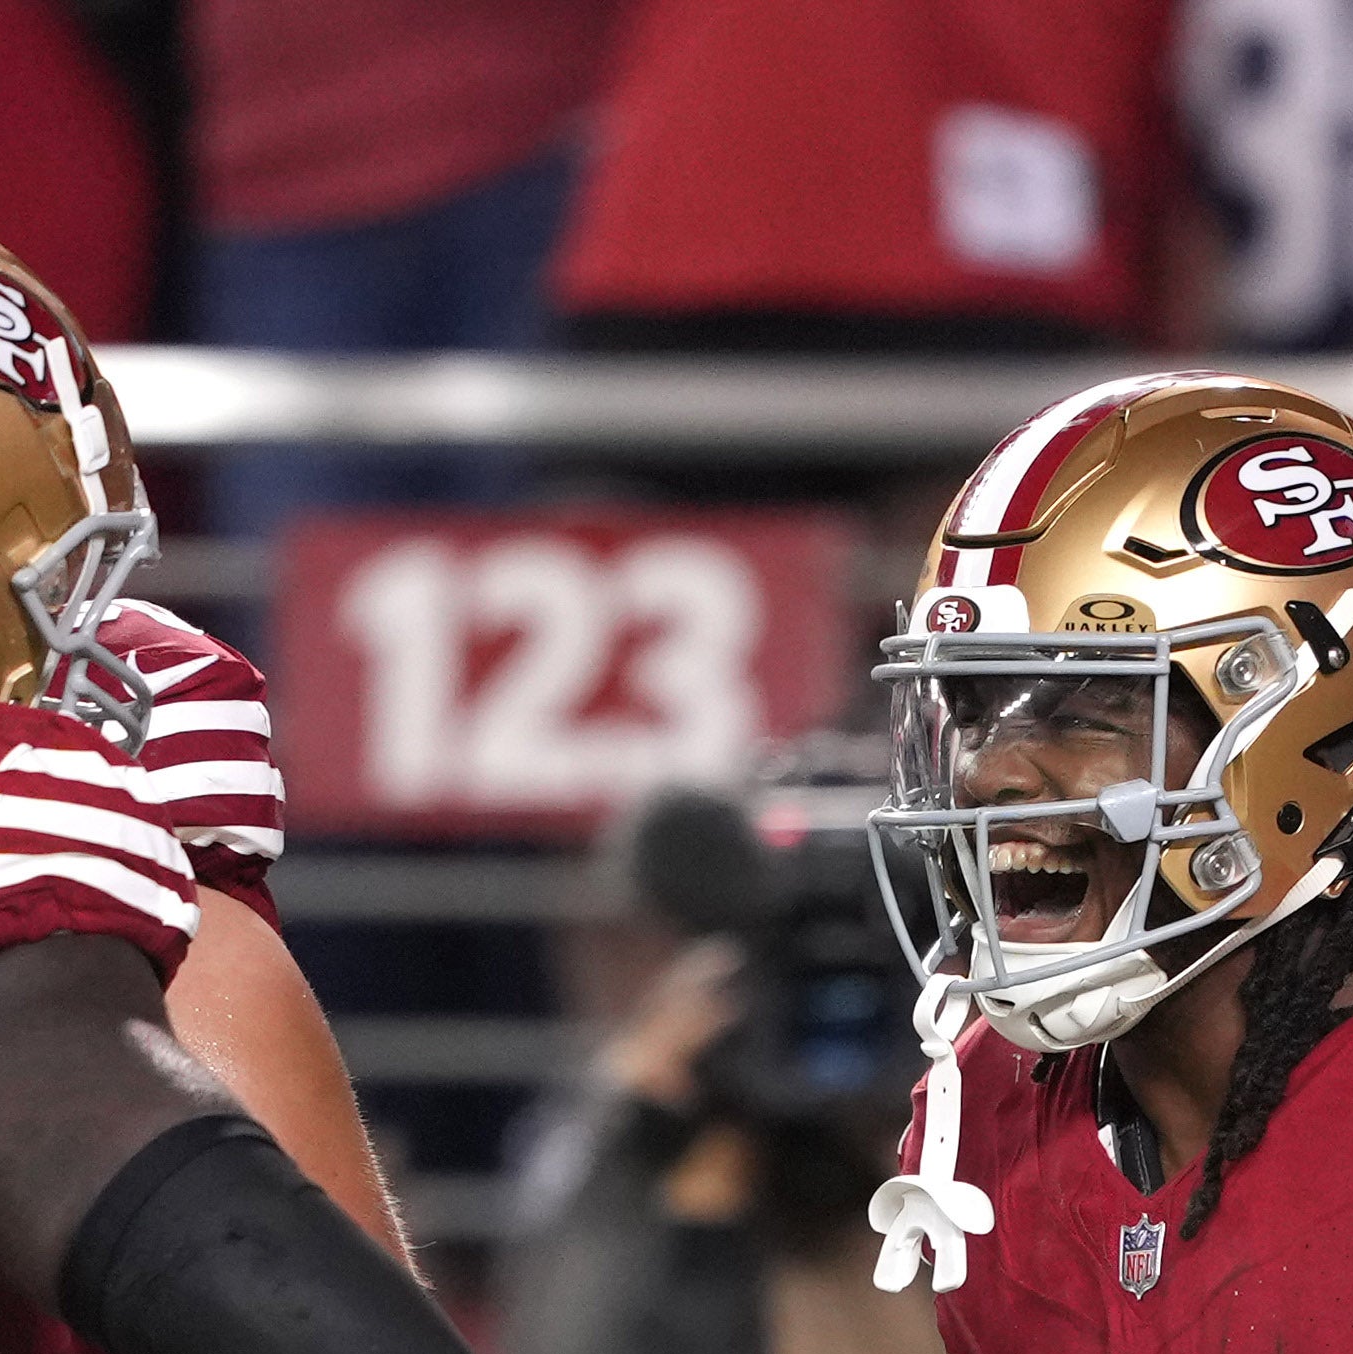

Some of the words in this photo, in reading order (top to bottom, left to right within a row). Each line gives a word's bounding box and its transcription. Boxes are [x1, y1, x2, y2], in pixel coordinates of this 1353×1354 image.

[937, 601, 967, 633] SF
[1065, 622, 1148, 633] OAKLEY
[339, 528, 761, 800] 123
[1126, 1251, 1153, 1283] NFL
